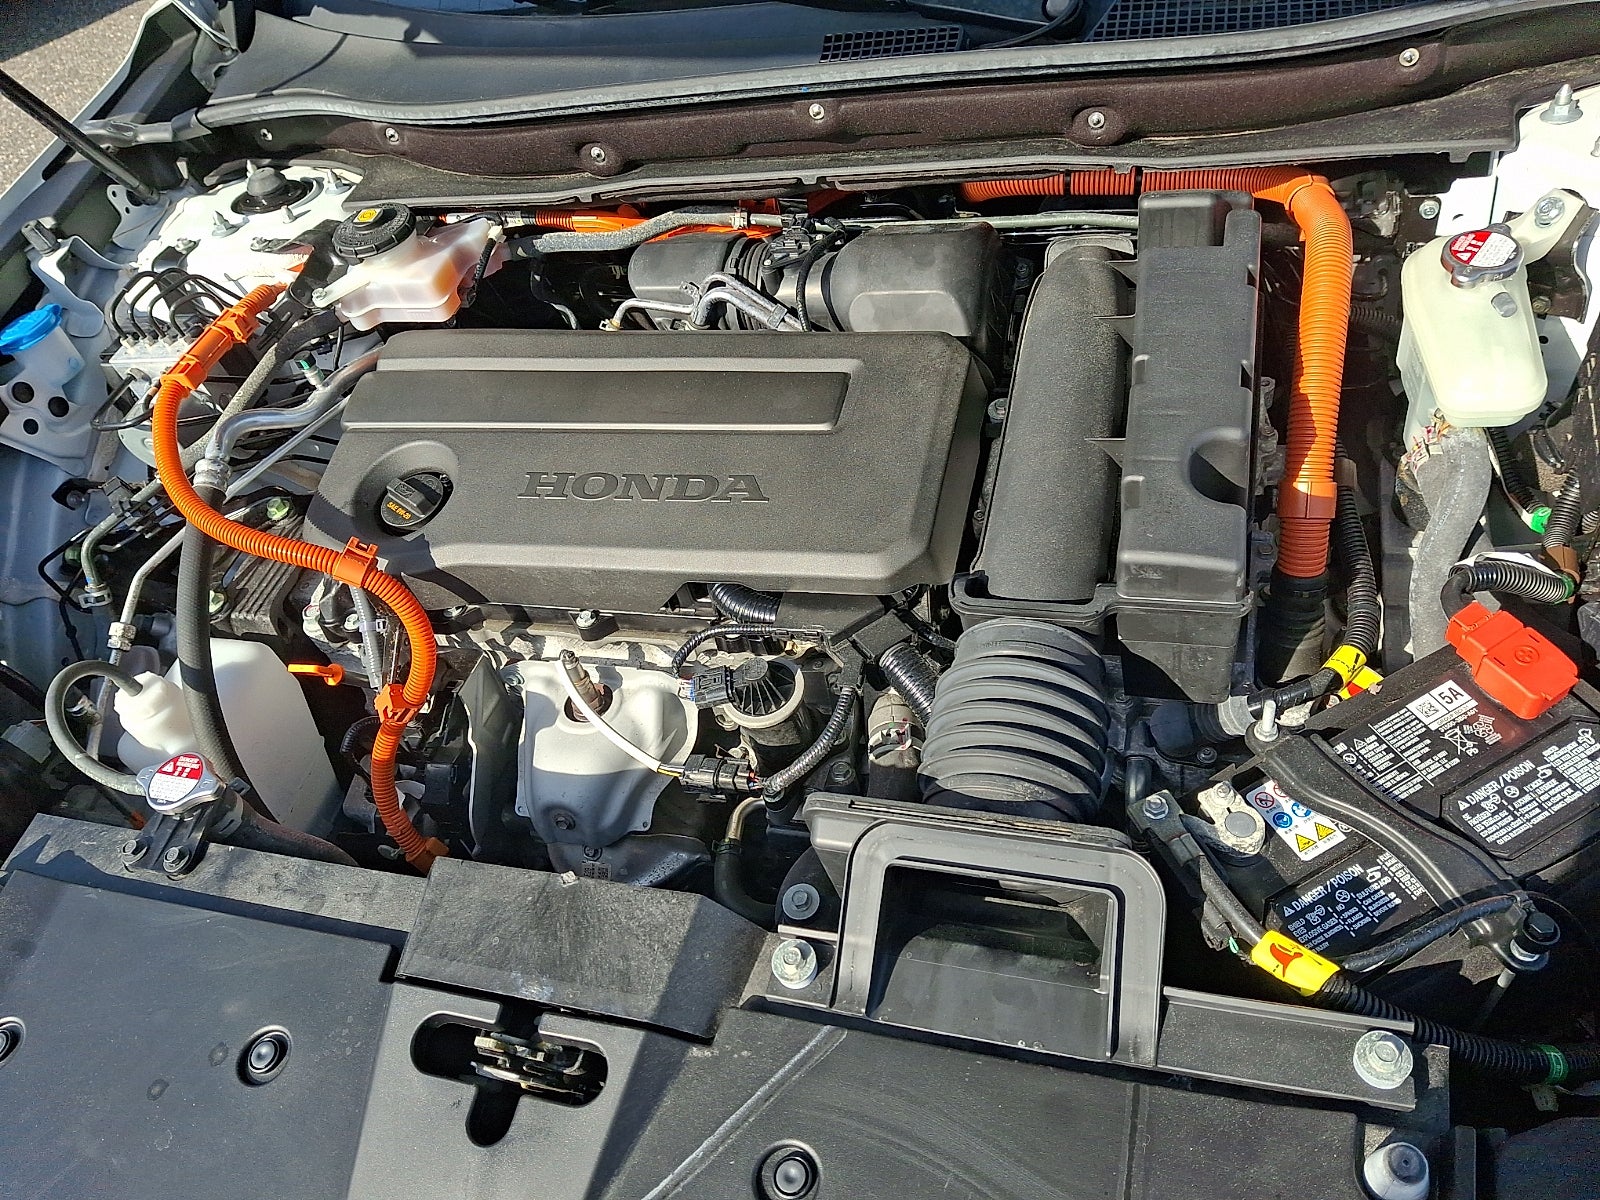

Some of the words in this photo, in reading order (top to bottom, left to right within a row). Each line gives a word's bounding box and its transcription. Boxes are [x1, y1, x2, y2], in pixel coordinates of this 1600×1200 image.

[517, 472, 770, 503] HONDA
[1438, 687, 1464, 705] 5A
[1465, 746, 1479, 757] Pb
[1465, 780, 1501, 805] DANGER
[1502, 759, 1536, 782] POISON
[1290, 885, 1327, 911] DANGER
[1330, 863, 1364, 887] POISON
[1356, 882, 1380, 899] SULFURIC
[1376, 875, 1392, 887] ACID
[1286, 917, 1306, 931] SHIELD
[1292, 926, 1307, 937] EYES
[1298, 926, 1324, 943] EXPLOSIVE
[1321, 916, 1338, 929] GASES
